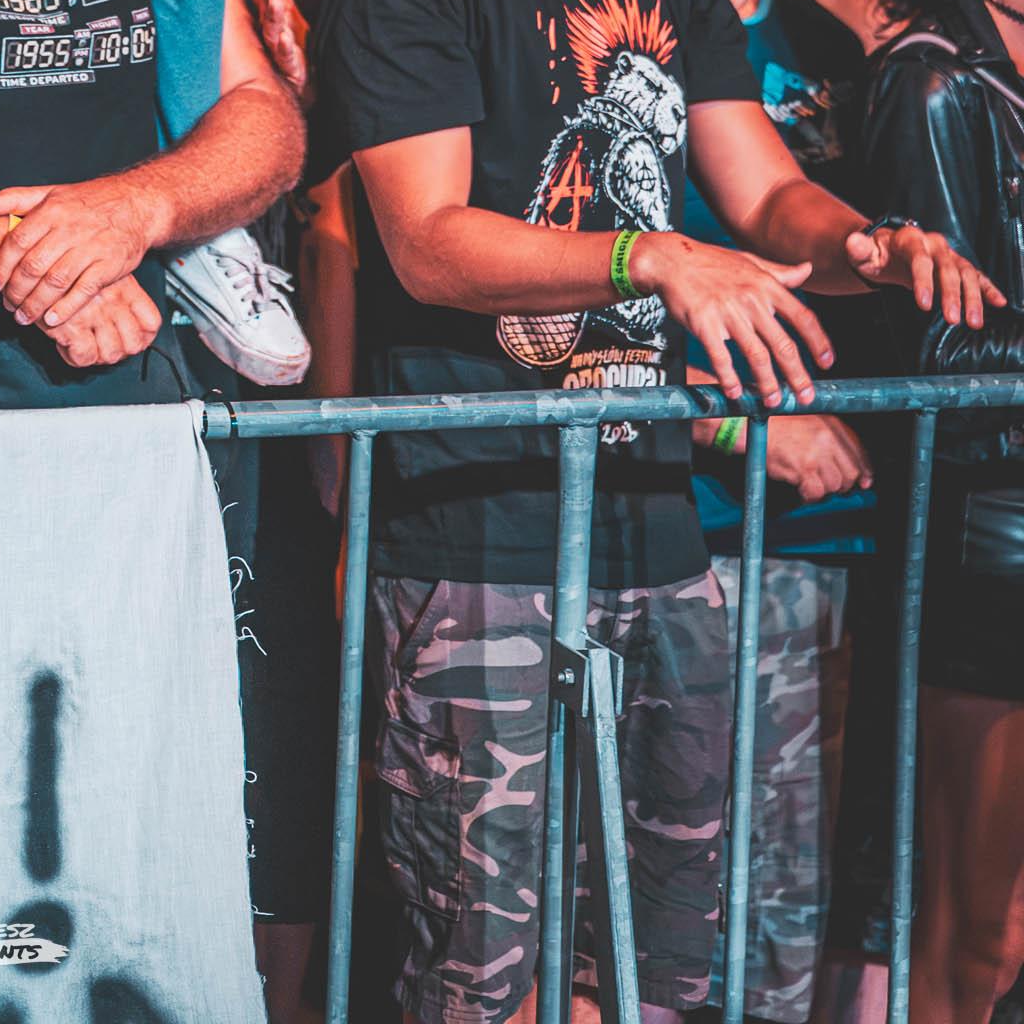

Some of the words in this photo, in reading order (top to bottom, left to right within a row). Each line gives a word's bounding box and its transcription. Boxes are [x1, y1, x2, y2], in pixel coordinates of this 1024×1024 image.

[25, 26, 51, 34] YEAR
[90, 19, 118, 29] HOUR
[14, 38, 71, 69] 1955
[0, 78, 27, 88] TIME
[29, 72, 89, 86] DEPARTED
